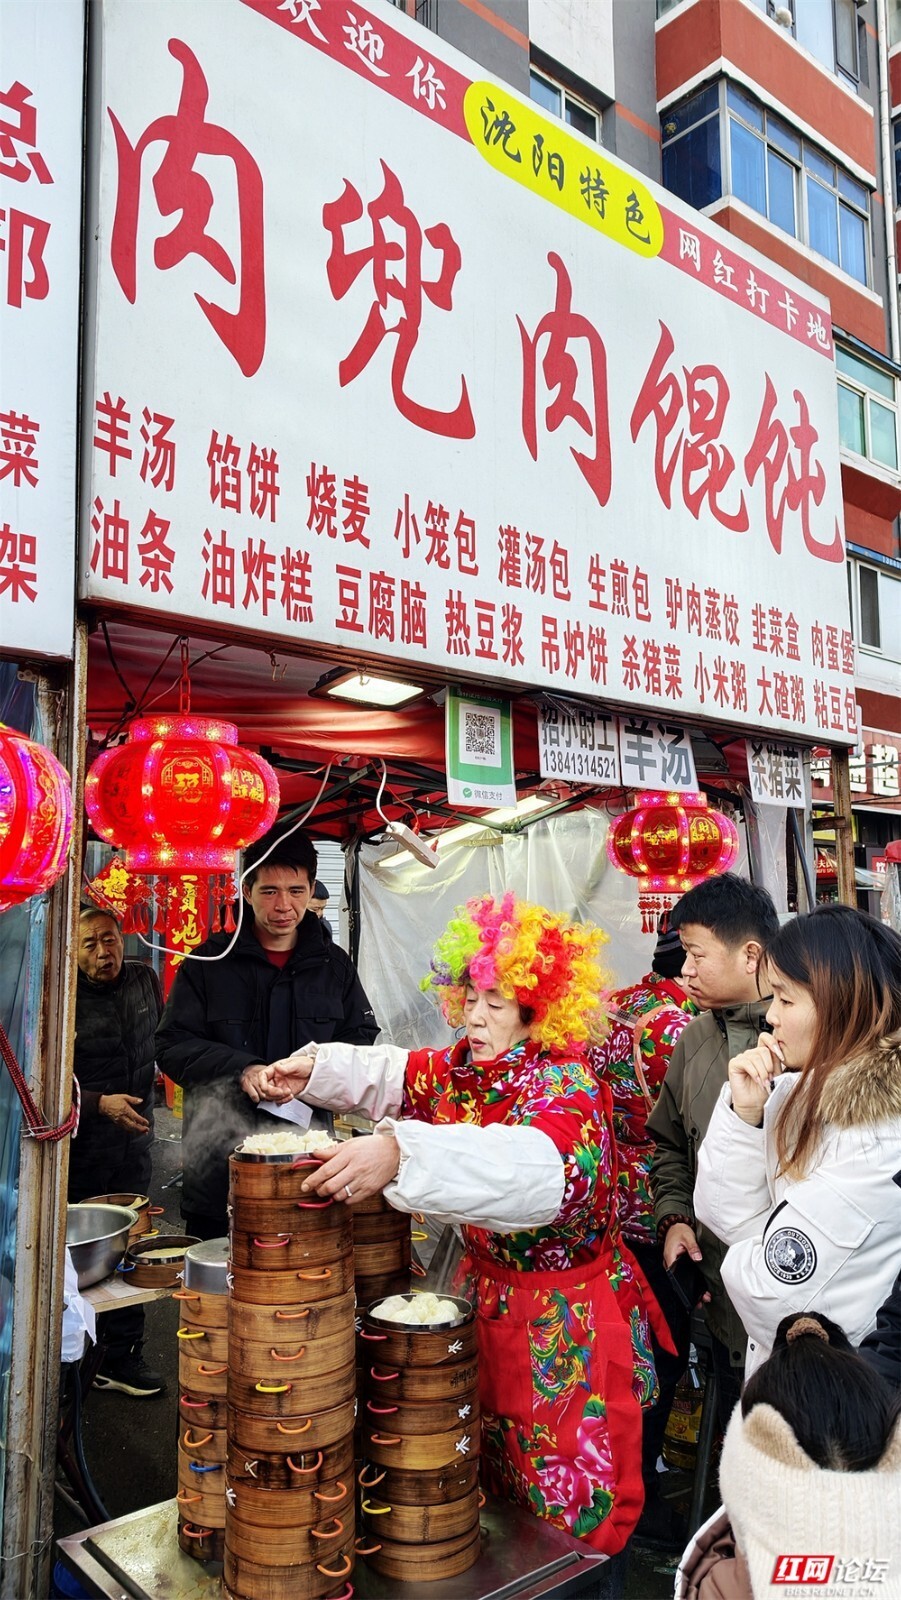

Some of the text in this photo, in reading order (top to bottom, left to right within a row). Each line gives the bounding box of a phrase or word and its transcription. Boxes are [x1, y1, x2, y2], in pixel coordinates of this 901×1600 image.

[480, 96, 652, 246] 沈阳特色
[107, 38, 844, 563] 肉兜肉馄饨
[678, 227, 831, 351] 网红打卡地
[93, 391, 855, 676] 羊汤 馅饼 烧麦 小笼包 灌汤包 生煎包 驴肉蒸饺 韭菜盒 肉蛋堡
[90, 495, 858, 735] 油条 油炸糕 豆腐脑 热豆浆 吊炉饼 杀猪菜 小米粥 大碴粥 粘豆包
[541, 704, 615, 752] 招小时工
[624, 717, 692, 785] 羊汤
[474, 789, 503, 801] 微信支付
[542, 748, 617, 779] 13841314521
[751, 742, 802, 800] 杀猪菜
[775, 1249, 797, 1271] CAMEL
[787, 1230, 812, 1253] OUTDOOR
